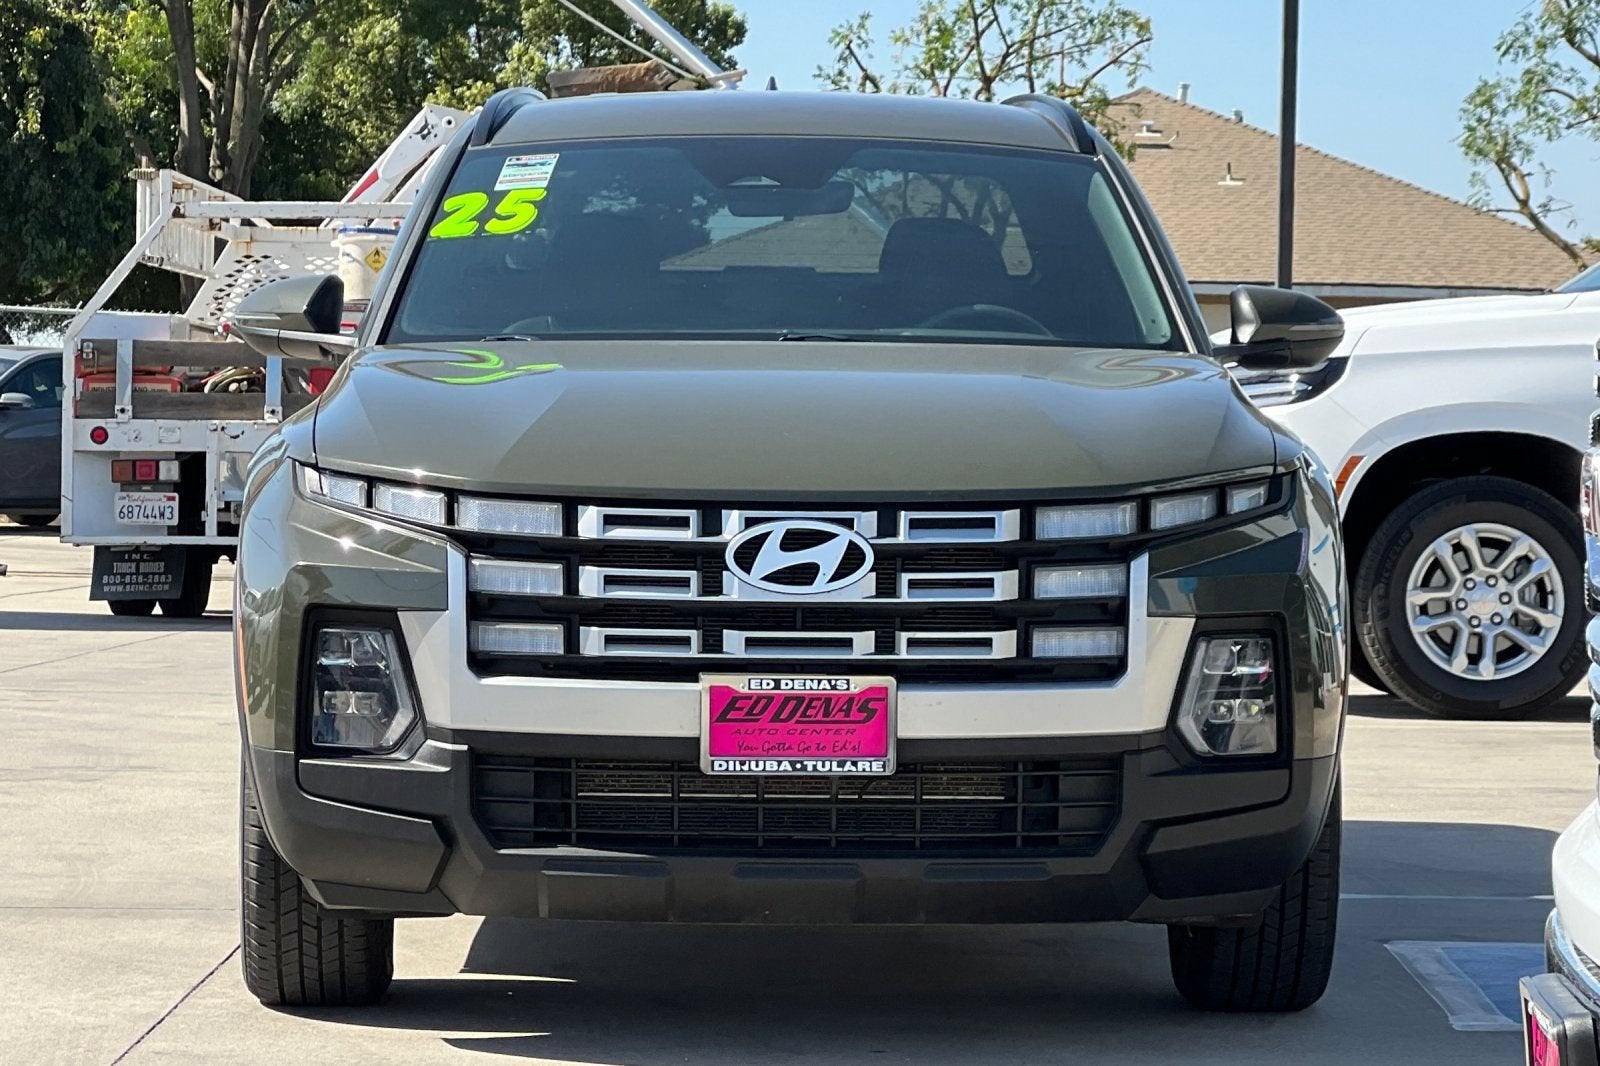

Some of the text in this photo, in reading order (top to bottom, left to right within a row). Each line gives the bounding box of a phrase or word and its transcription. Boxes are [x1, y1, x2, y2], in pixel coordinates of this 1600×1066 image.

[429, 188, 547, 238] 25
[118, 504, 174, 520] 68744W3
[113, 561, 165, 573] TRUCK BODIES
[750, 679, 848, 690] ED DENA'S
[713, 695, 886, 724] ED DENA'S
[731, 728, 857, 736] AUTO CENTER
[737, 740, 861, 754] You Gotta Go to Ed's!
[713, 760, 884, 771] DINUBA TULARE
